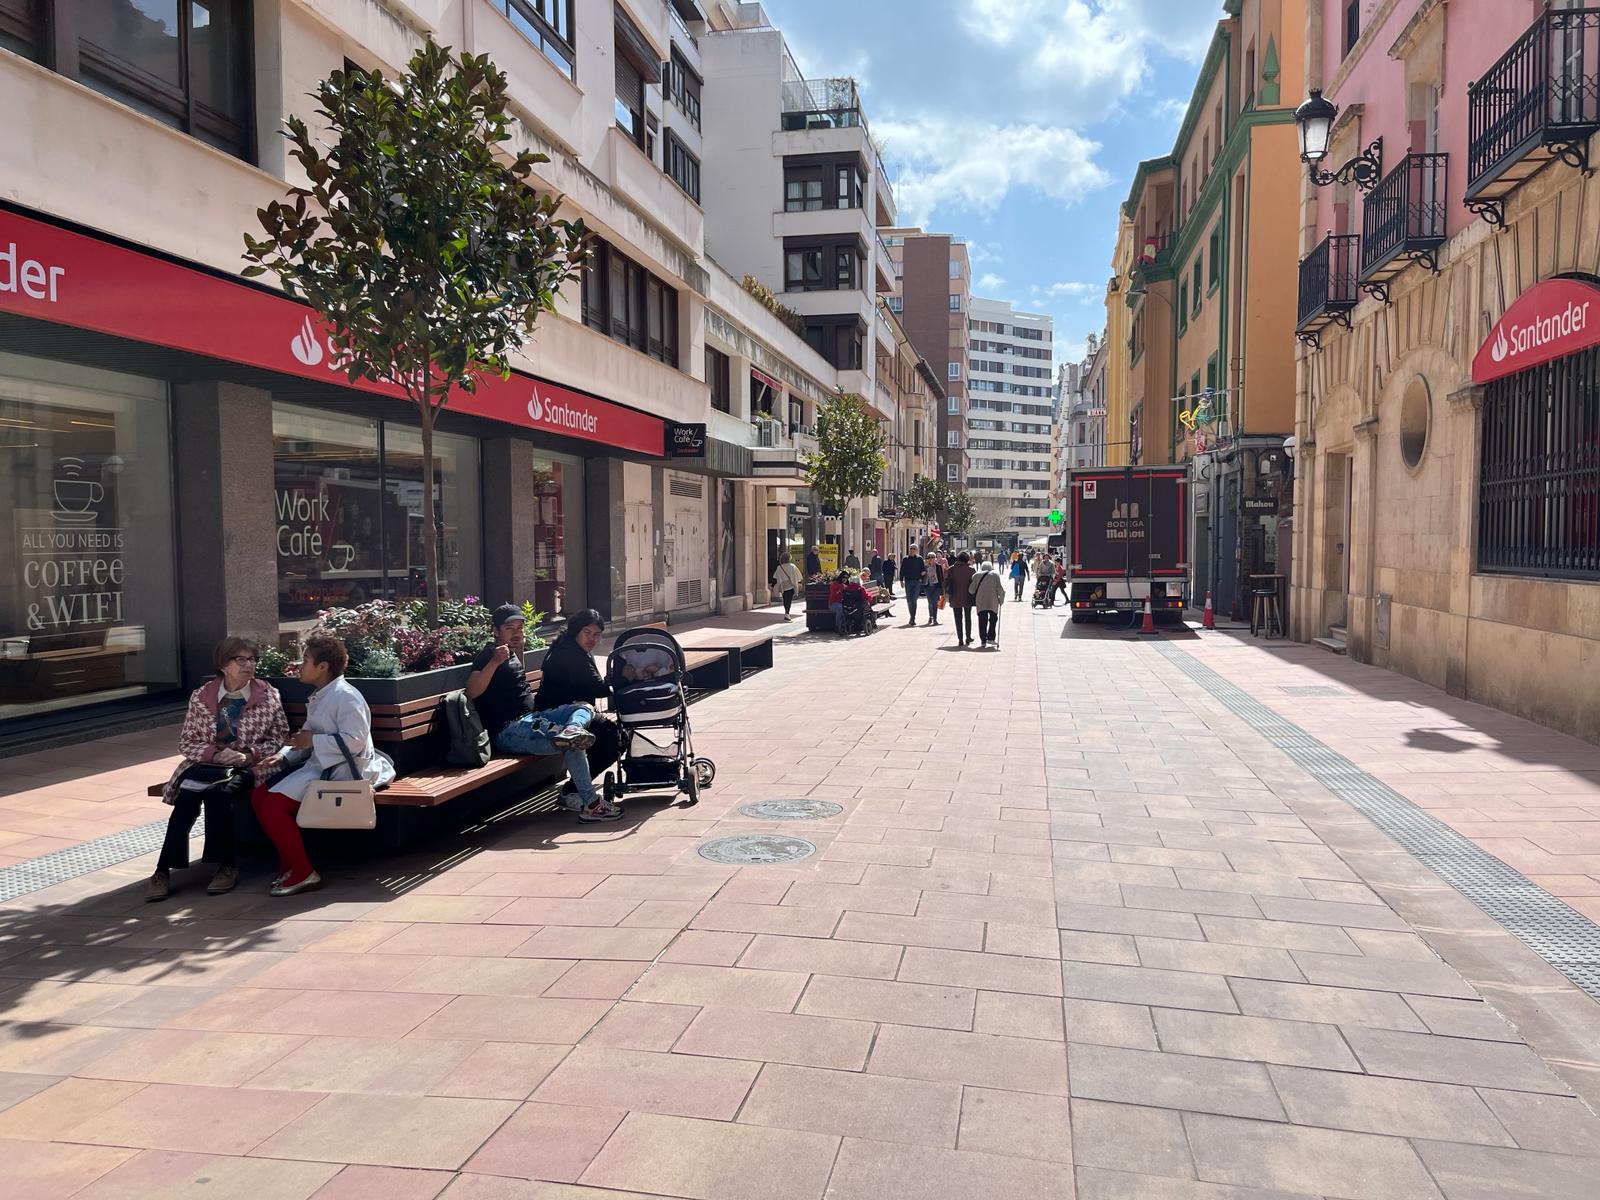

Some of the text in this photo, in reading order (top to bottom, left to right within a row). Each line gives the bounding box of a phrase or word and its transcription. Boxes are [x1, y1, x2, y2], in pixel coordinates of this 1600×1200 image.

[0, 242, 65, 302] der
[1509, 301, 1589, 356] Santander
[544, 397, 598, 433] Santander
[274, 489, 330, 521] Work
[1245, 500, 1274, 508] Mahou
[23, 533, 124, 548] ALL YOU NEED IS
[276, 525, 322, 556] Café
